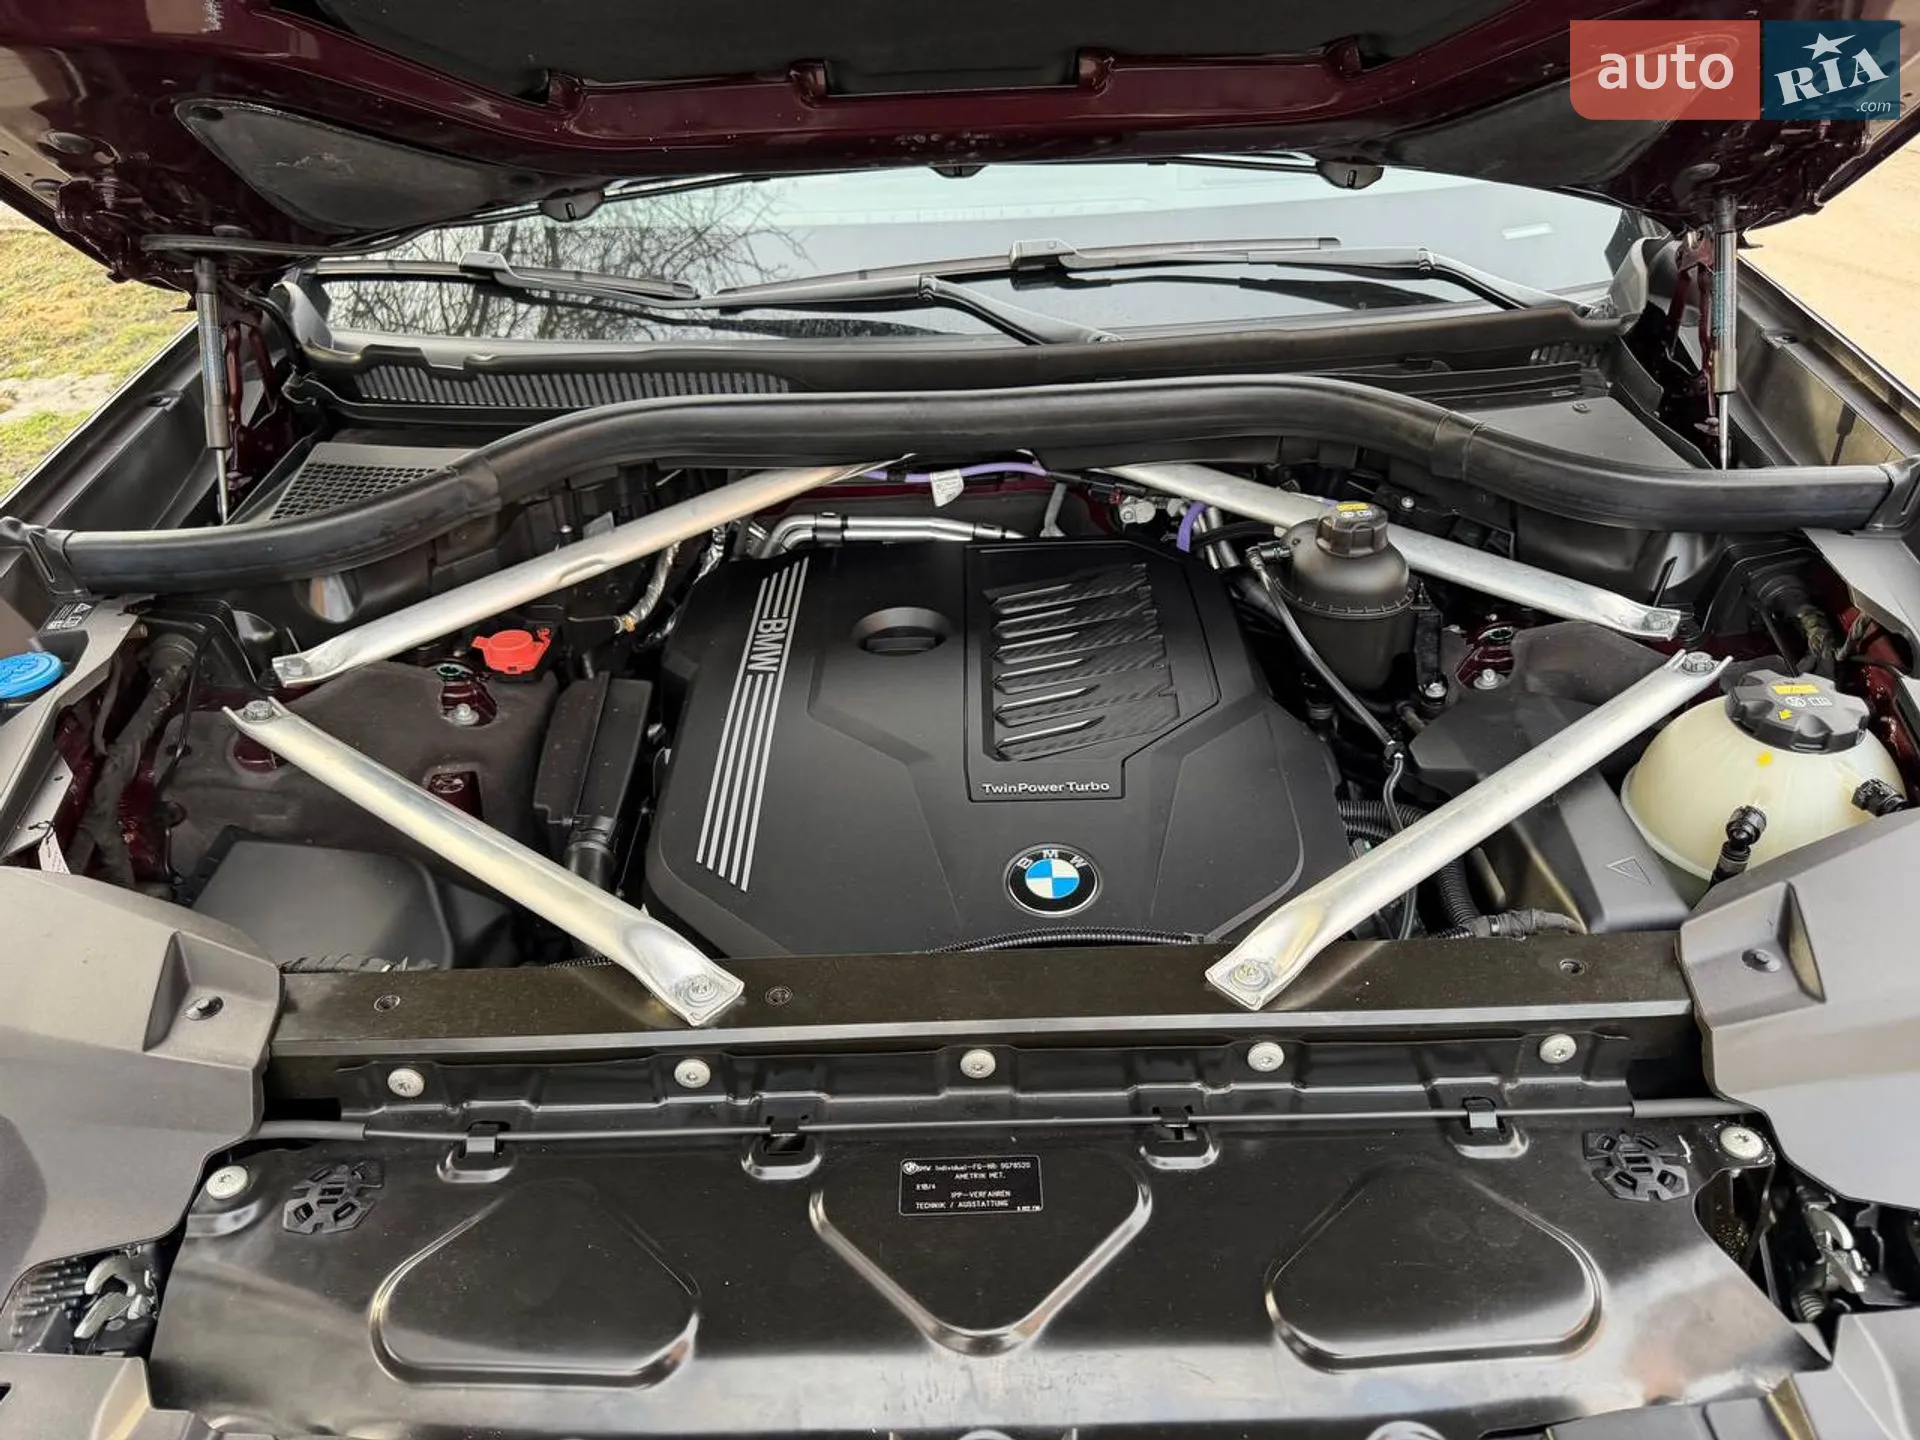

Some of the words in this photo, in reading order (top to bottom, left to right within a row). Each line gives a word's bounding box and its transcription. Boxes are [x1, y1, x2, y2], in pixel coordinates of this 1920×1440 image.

[747, 617, 789, 672] BMW
[1016, 849, 1089, 869] BMW
[957, 1200, 1009, 1208] AUSSTATTUNG
